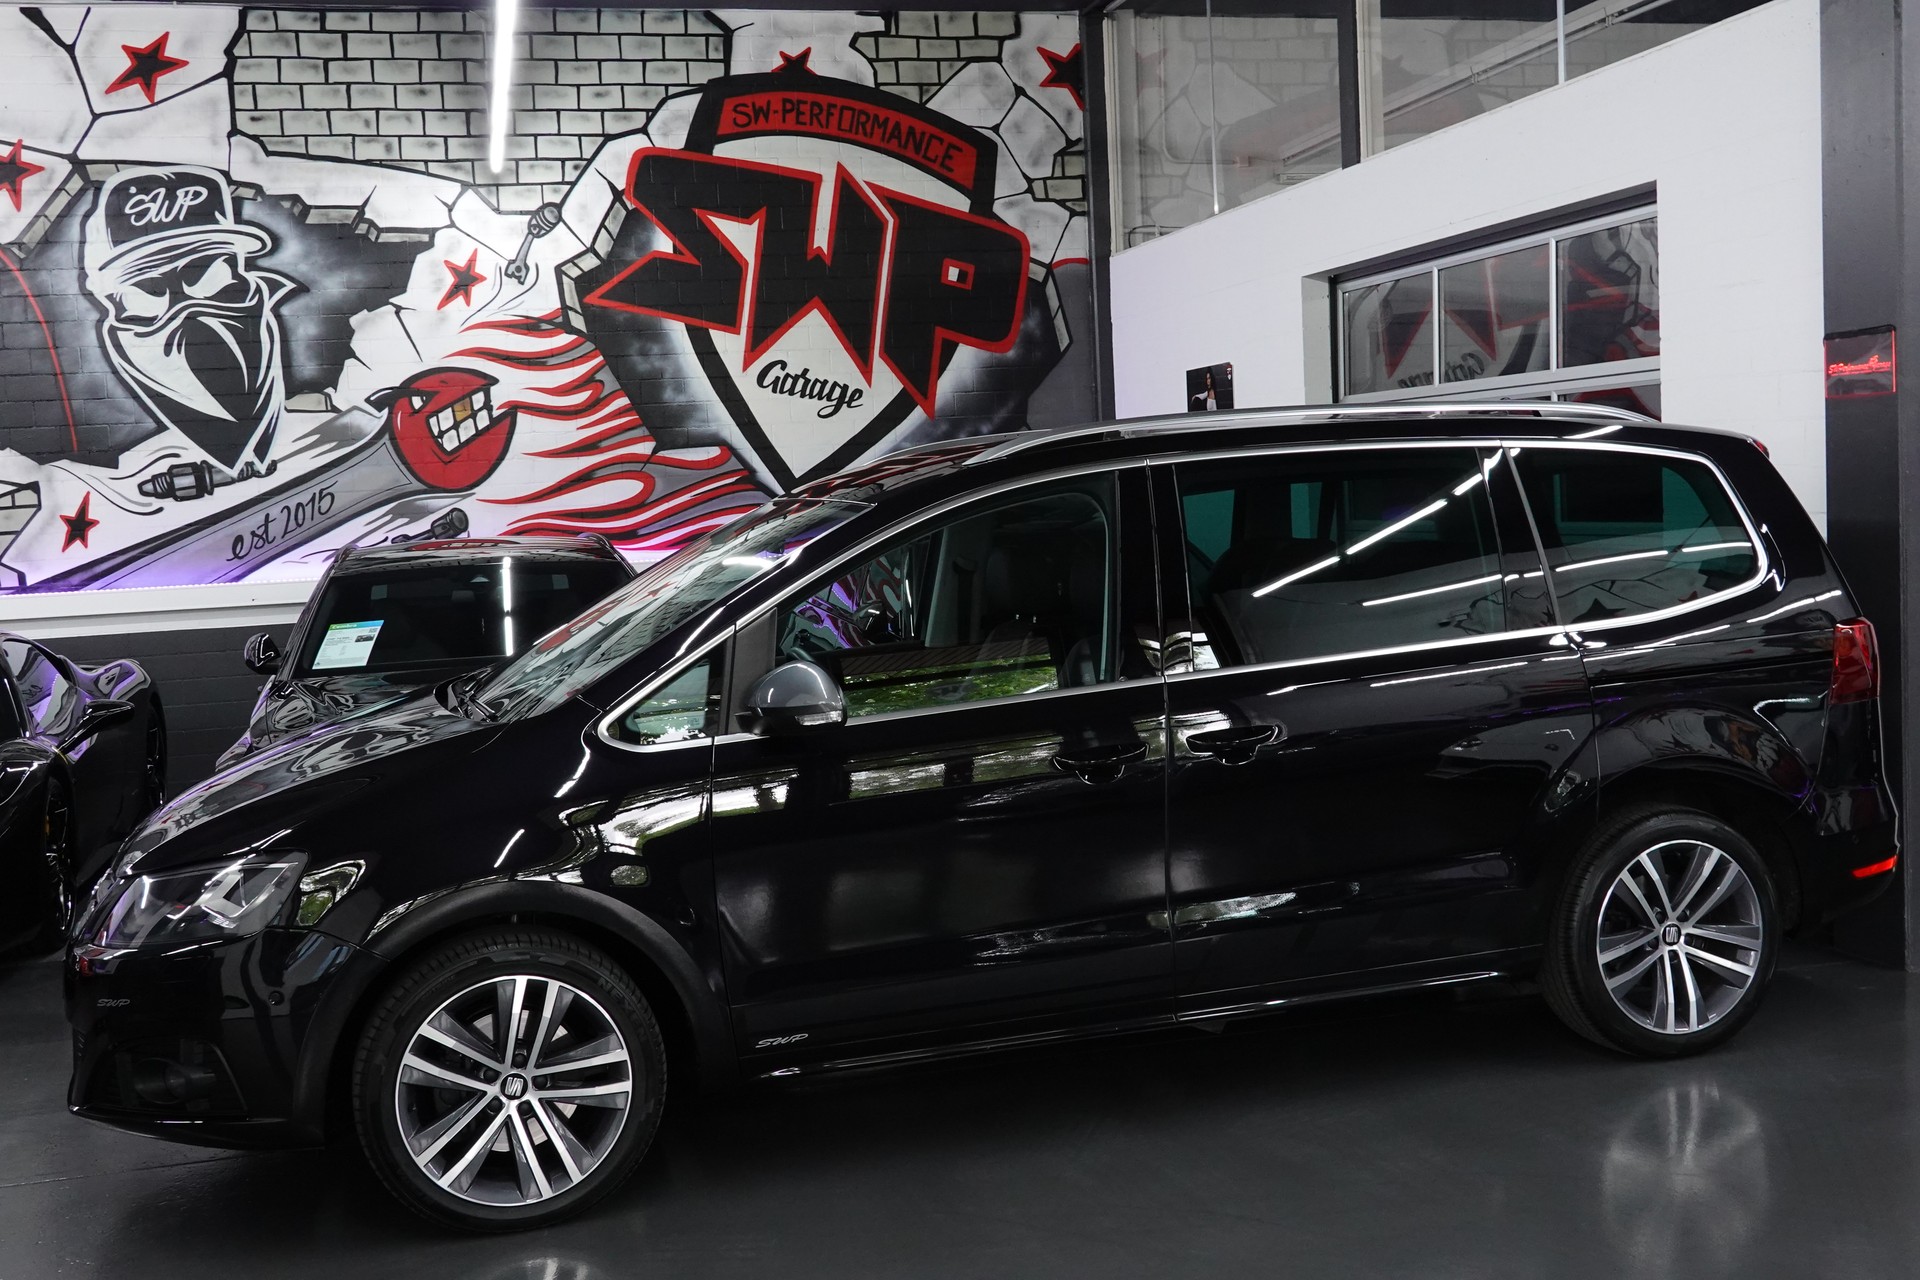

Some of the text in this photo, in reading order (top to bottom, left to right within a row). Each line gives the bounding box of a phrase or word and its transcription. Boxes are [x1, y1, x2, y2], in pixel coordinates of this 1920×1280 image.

[731, 97, 963, 174] SW-PERFORMANCE
[124, 185, 208, 226] SWP
[584, 147, 1031, 420] SWP
[756, 359, 863, 419] Garage
[226, 480, 338, 561] est 2015
[96, 998, 131, 1007] SWP
[755, 1033, 809, 1048] SWP
